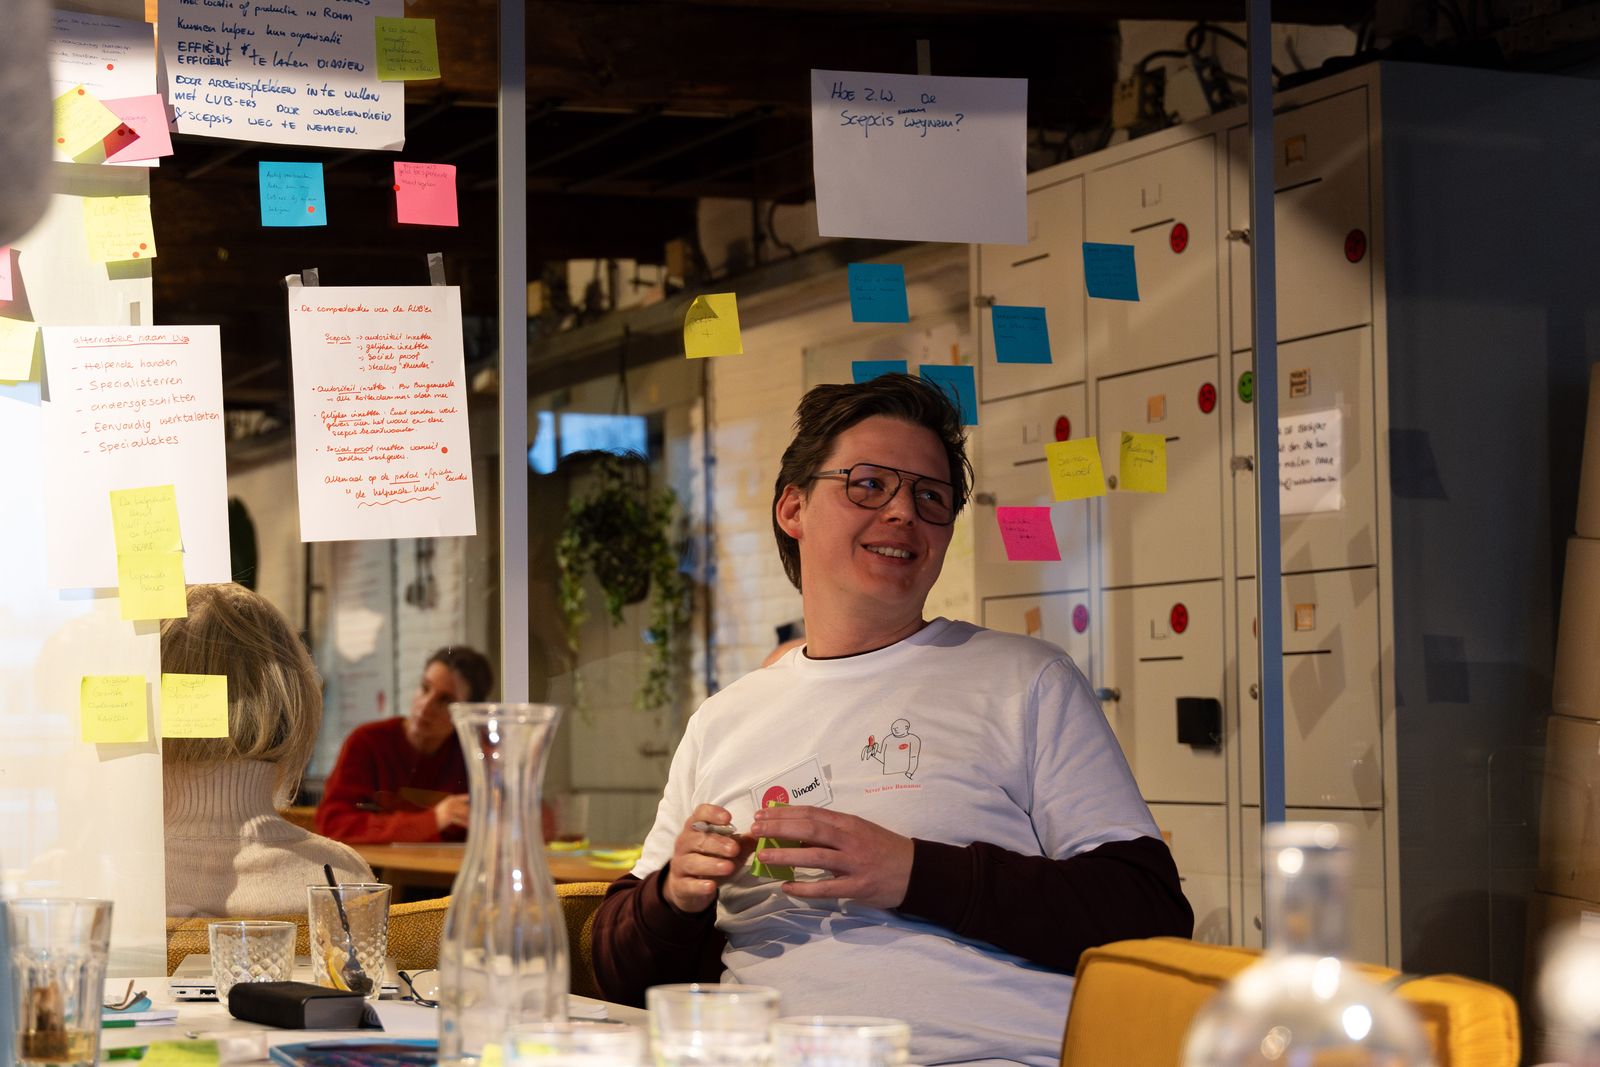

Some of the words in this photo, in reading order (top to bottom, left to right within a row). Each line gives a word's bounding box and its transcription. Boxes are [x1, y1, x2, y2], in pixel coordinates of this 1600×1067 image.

[301, 304, 313, 313] De
[392, 304, 404, 313] de
[138, 334, 167, 343] naam
[398, 352, 421, 363] proof
[140, 358, 178, 369] handen
[791, 776, 821, 799] Vincent
